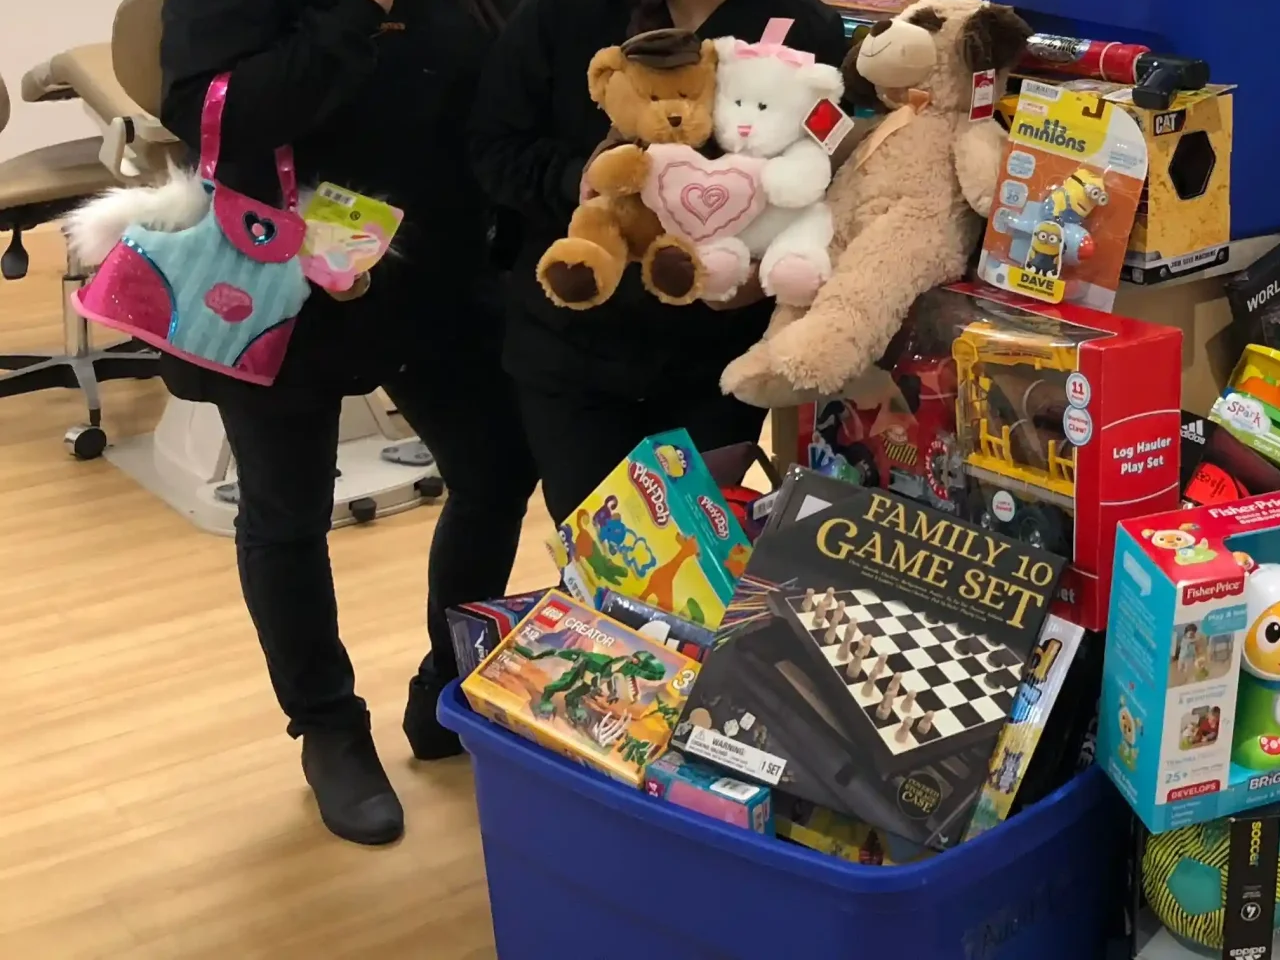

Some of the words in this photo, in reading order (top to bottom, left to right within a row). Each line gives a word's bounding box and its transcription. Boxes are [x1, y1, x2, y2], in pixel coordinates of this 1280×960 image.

[1155, 112, 1178, 135] CAT
[1017, 121, 1086, 153] minions
[1021, 273, 1055, 290] DAVE
[1071, 381, 1085, 395] 11
[1227, 400, 1263, 428] Spark
[1180, 428, 1206, 445] adidas
[1113, 447, 1135, 460] Log
[1136, 437, 1172, 455] Hauler
[1120, 460, 1145, 476] Play
[1147, 454, 1165, 469] Set
[633, 461, 671, 526] Play-Doh
[701, 495, 729, 538] Play-Doh
[862, 493, 1012, 568] FAMILY
[1011, 555, 1054, 587] 10
[816, 518, 955, 588] GAME
[958, 569, 1045, 629] SET
[1186, 579, 1242, 599] Fisher-Price
[564, 616, 616, 648] CREATOR
[766, 763, 782, 777] SET
[901, 791, 933, 814] CASE
[1171, 783, 1218, 800] DEVELOPS
[1249, 820, 1263, 867] soccer
[1229, 945, 1267, 957] adidas
